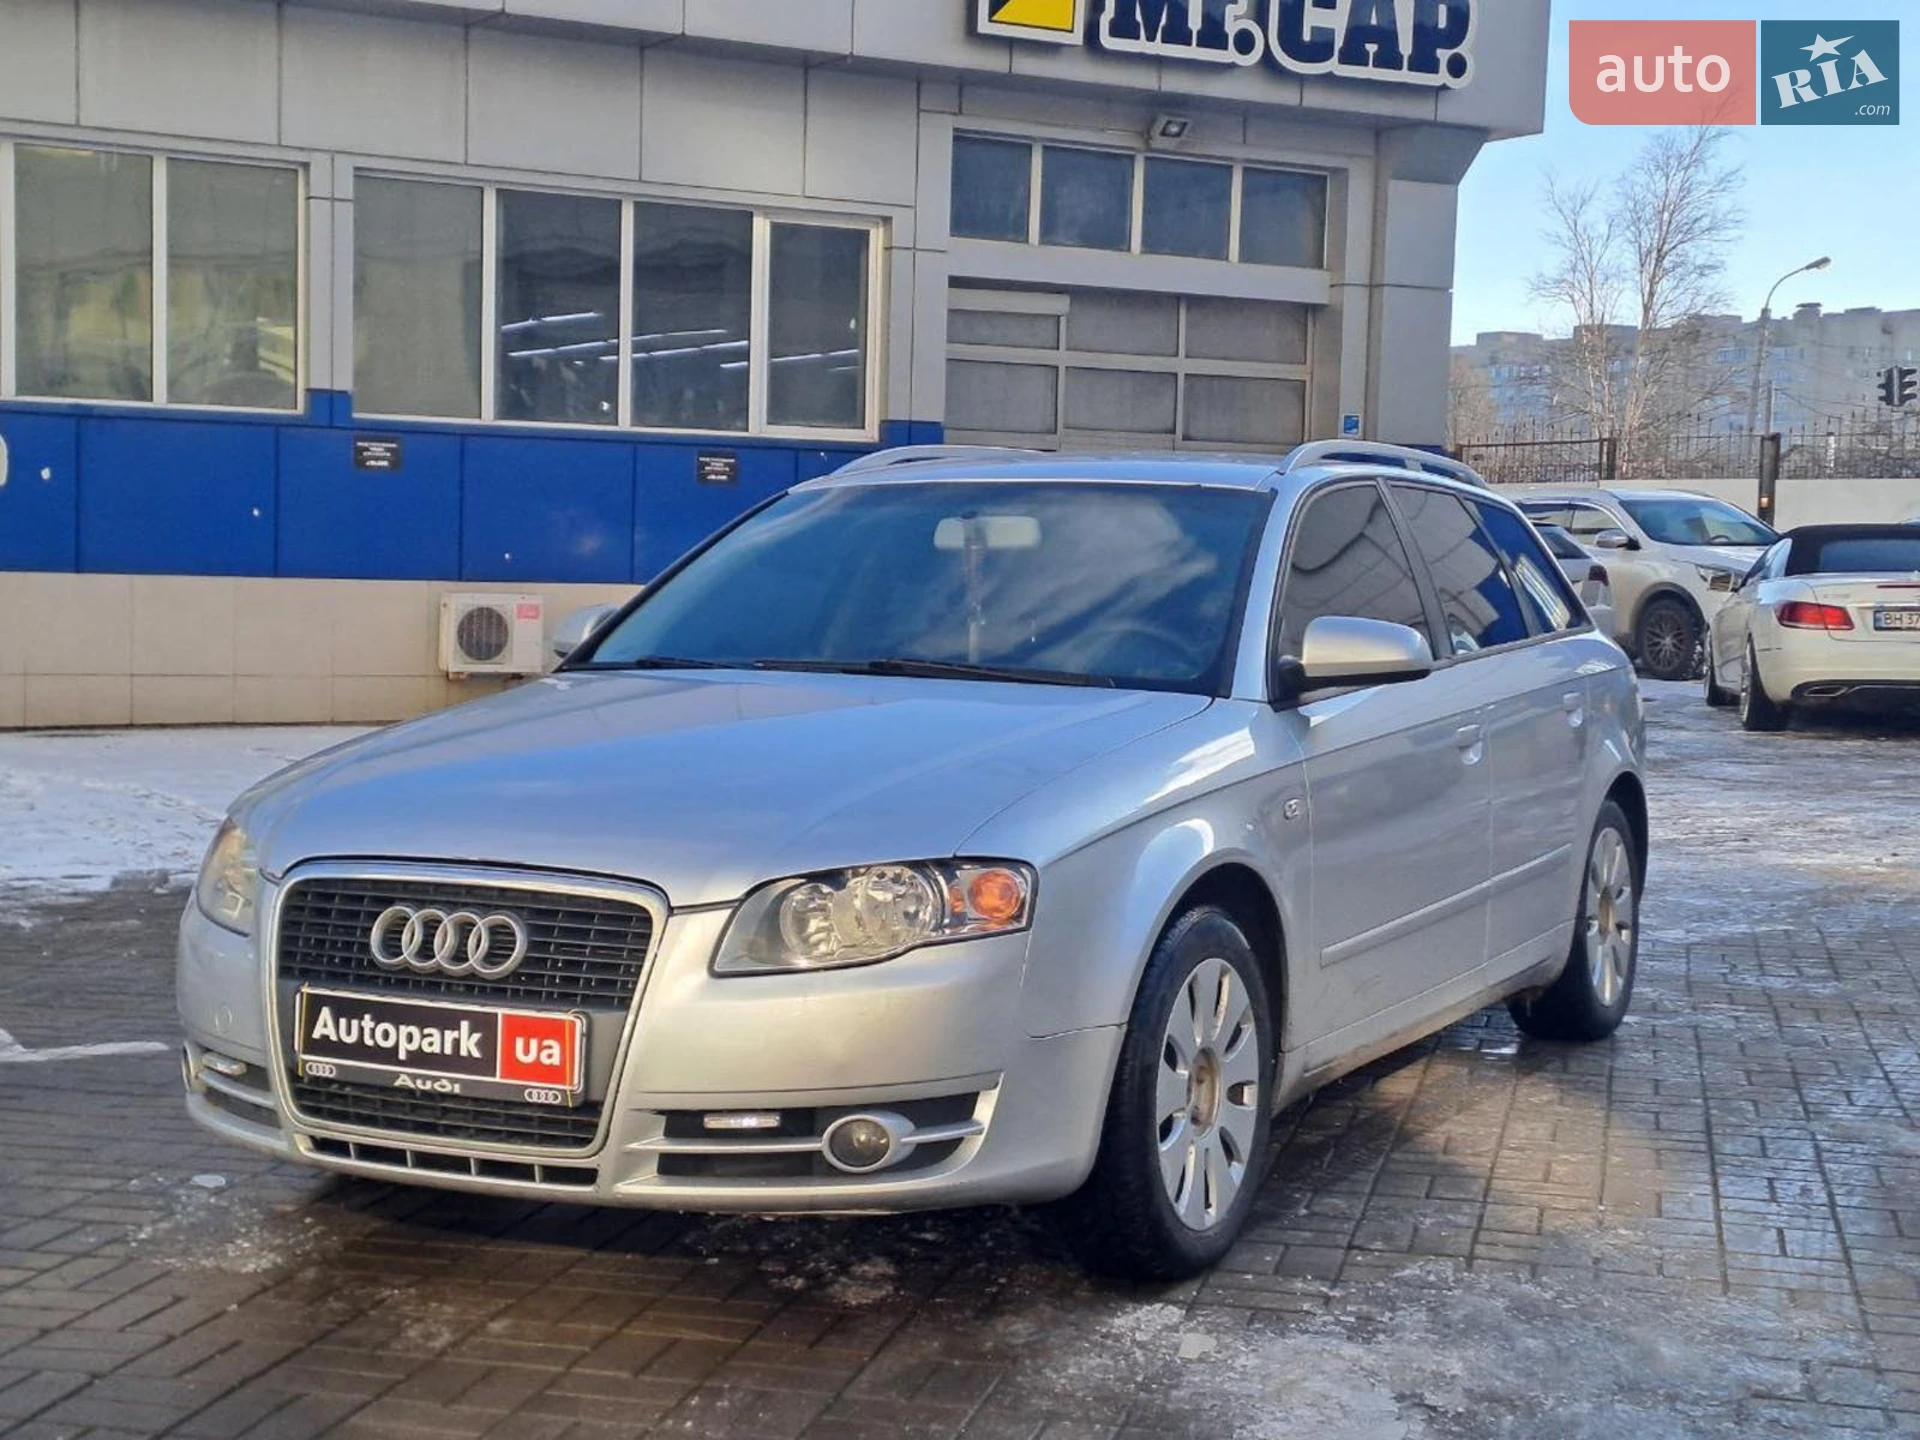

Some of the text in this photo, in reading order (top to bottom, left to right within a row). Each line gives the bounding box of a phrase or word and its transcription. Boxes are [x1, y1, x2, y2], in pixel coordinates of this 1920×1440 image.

[1884, 612, 1904, 625] BH
[311, 1006, 561, 1067] Autopark ua
[393, 1073, 461, 1094] Audi
